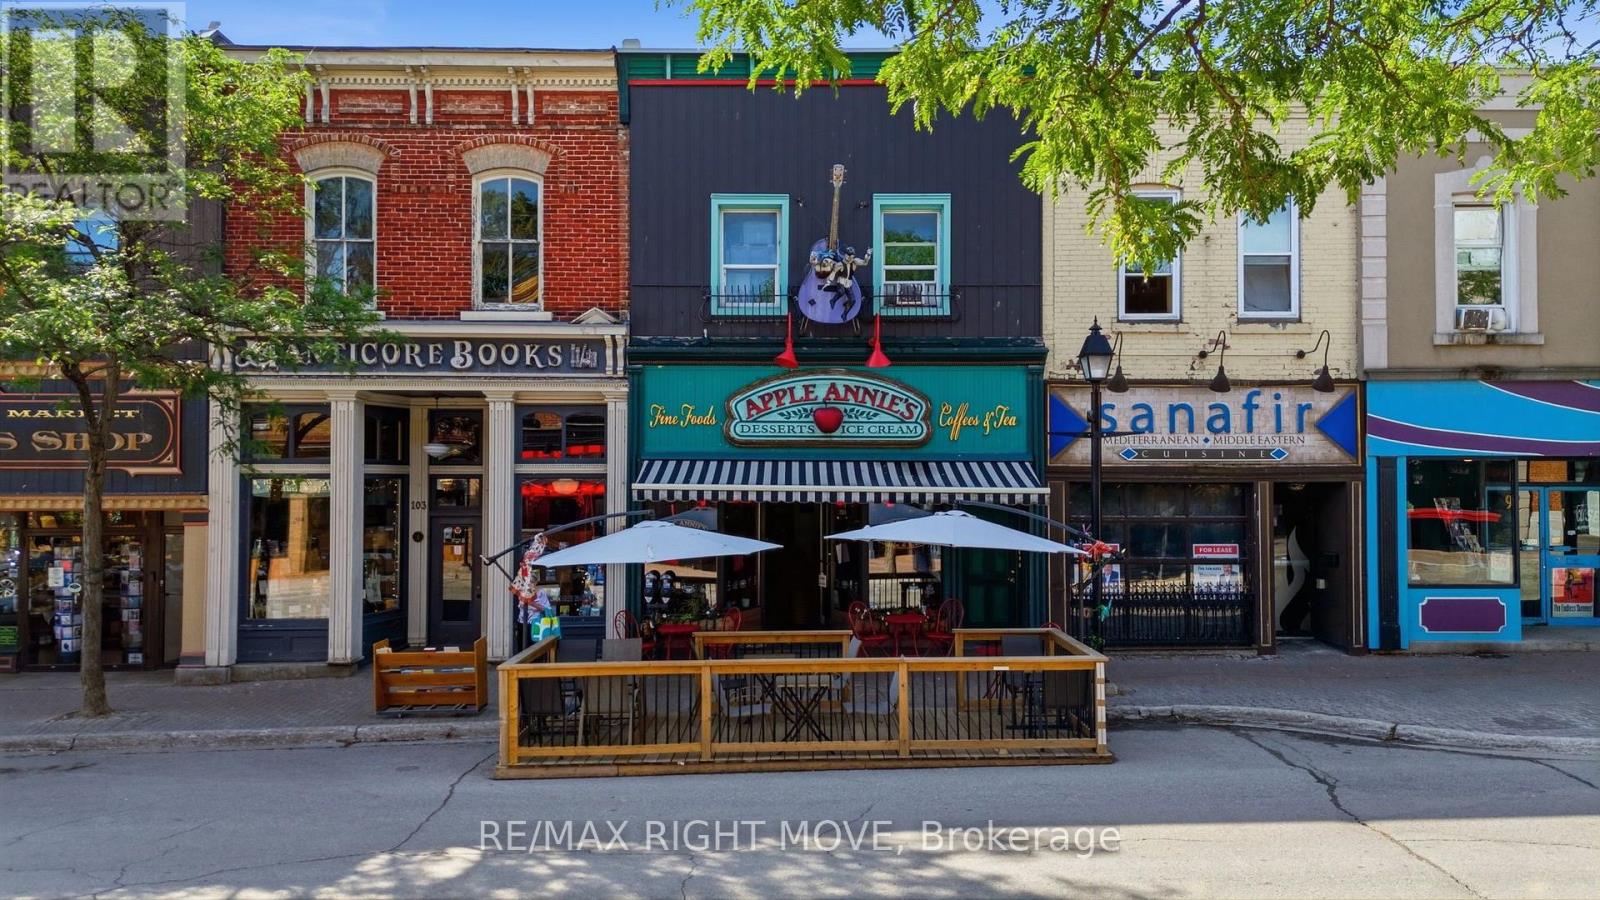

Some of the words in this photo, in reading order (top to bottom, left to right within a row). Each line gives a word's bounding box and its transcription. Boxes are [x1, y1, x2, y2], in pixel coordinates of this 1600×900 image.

[450, 340, 562, 369] BOOKS
[745, 383, 818, 420] APPLE
[823, 382, 918, 420] ANNIE'S
[7, 409, 140, 418] MART
[649, 404, 678, 428] Fine
[680, 404, 718, 428] Foods
[1100, 390, 1312, 433] sanafir
[740, 424, 815, 434] DESSERTS
[842, 425, 864, 434] ICE
[867, 425, 919, 434] CREAM
[939, 402, 979, 441] Coffees
[994, 405, 1017, 428] Tea
[1103, 435, 1199, 445] MEDITERRANEAN
[1213, 435, 1255, 445] MIDDLE
[1257, 435, 1305, 445] EASTERN
[1141, 450, 1265, 458] CUISINE
[411, 501, 427, 510] 103
